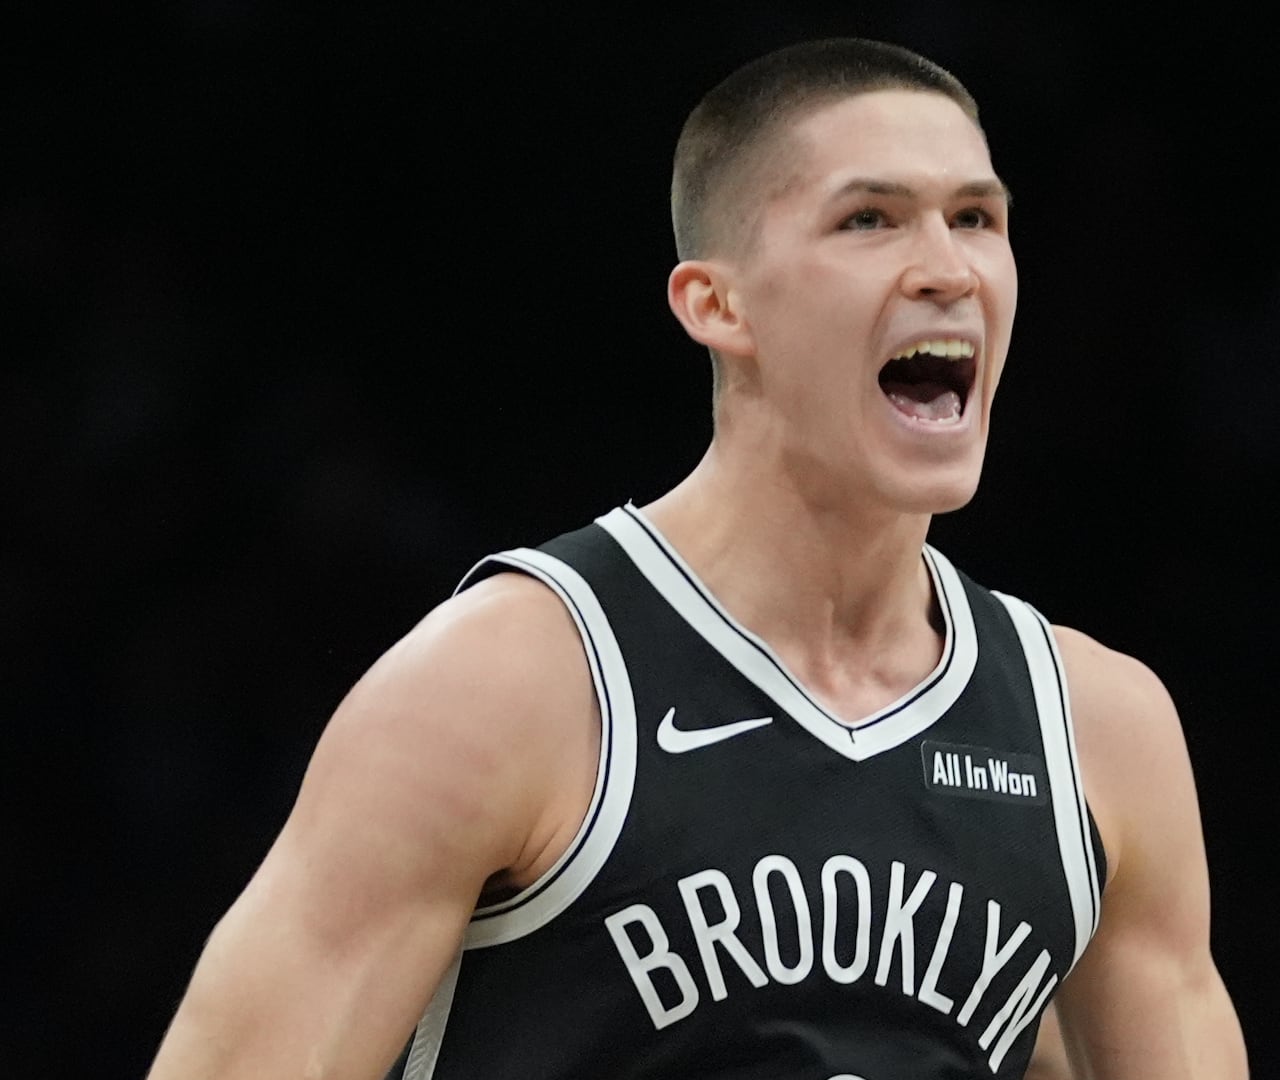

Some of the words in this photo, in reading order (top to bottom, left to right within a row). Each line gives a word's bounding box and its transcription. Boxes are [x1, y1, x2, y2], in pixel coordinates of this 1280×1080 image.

[932, 751, 961, 787] All
[965, 755, 988, 790] In
[987, 758, 1037, 797] Won
[605, 855, 1058, 1073] BROOKLYN
